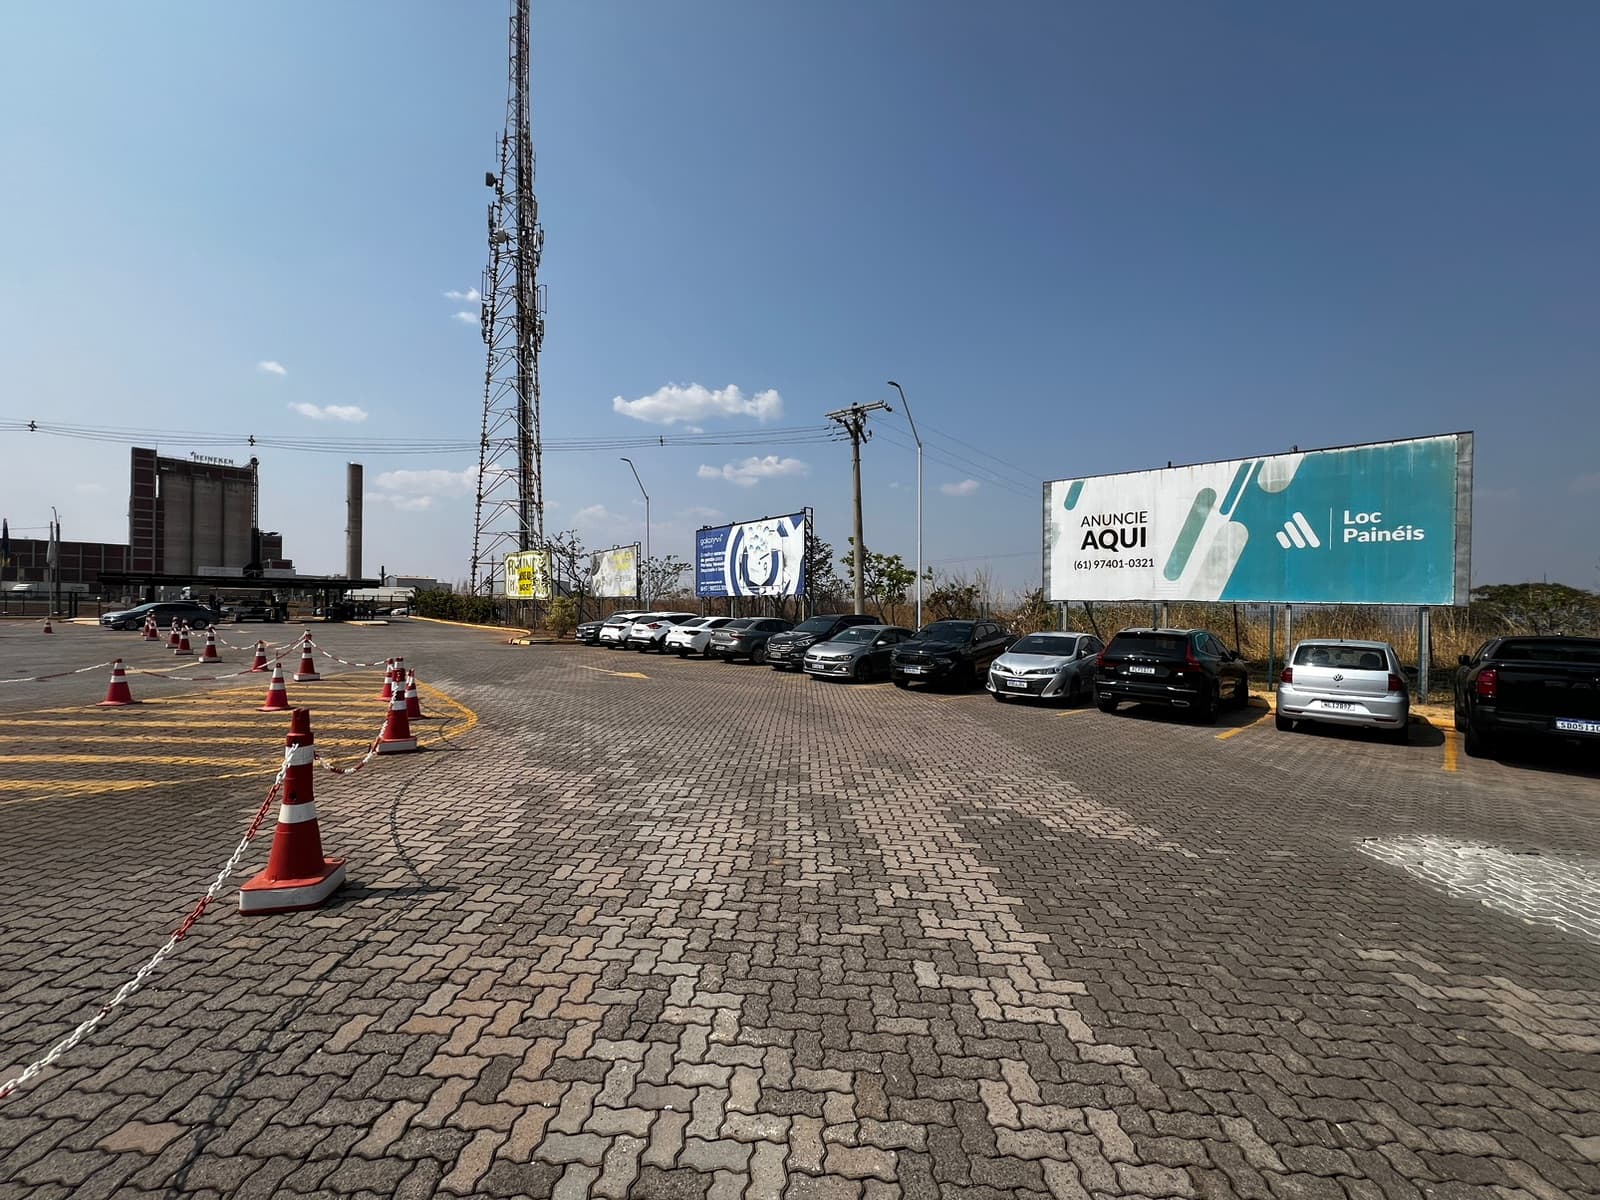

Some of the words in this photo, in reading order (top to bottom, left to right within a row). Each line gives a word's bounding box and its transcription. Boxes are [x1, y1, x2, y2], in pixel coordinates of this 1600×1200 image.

[194, 453, 234, 465] HEINEKEN
[1080, 511, 1148, 528] ANUNCIE
[1343, 510, 1382, 525] Loc
[1080, 527, 1147, 552] AQUI
[1343, 525, 1425, 543] Painéis
[1073, 560, 1092, 570] (61)
[1093, 558, 1154, 569] 97401-0321
